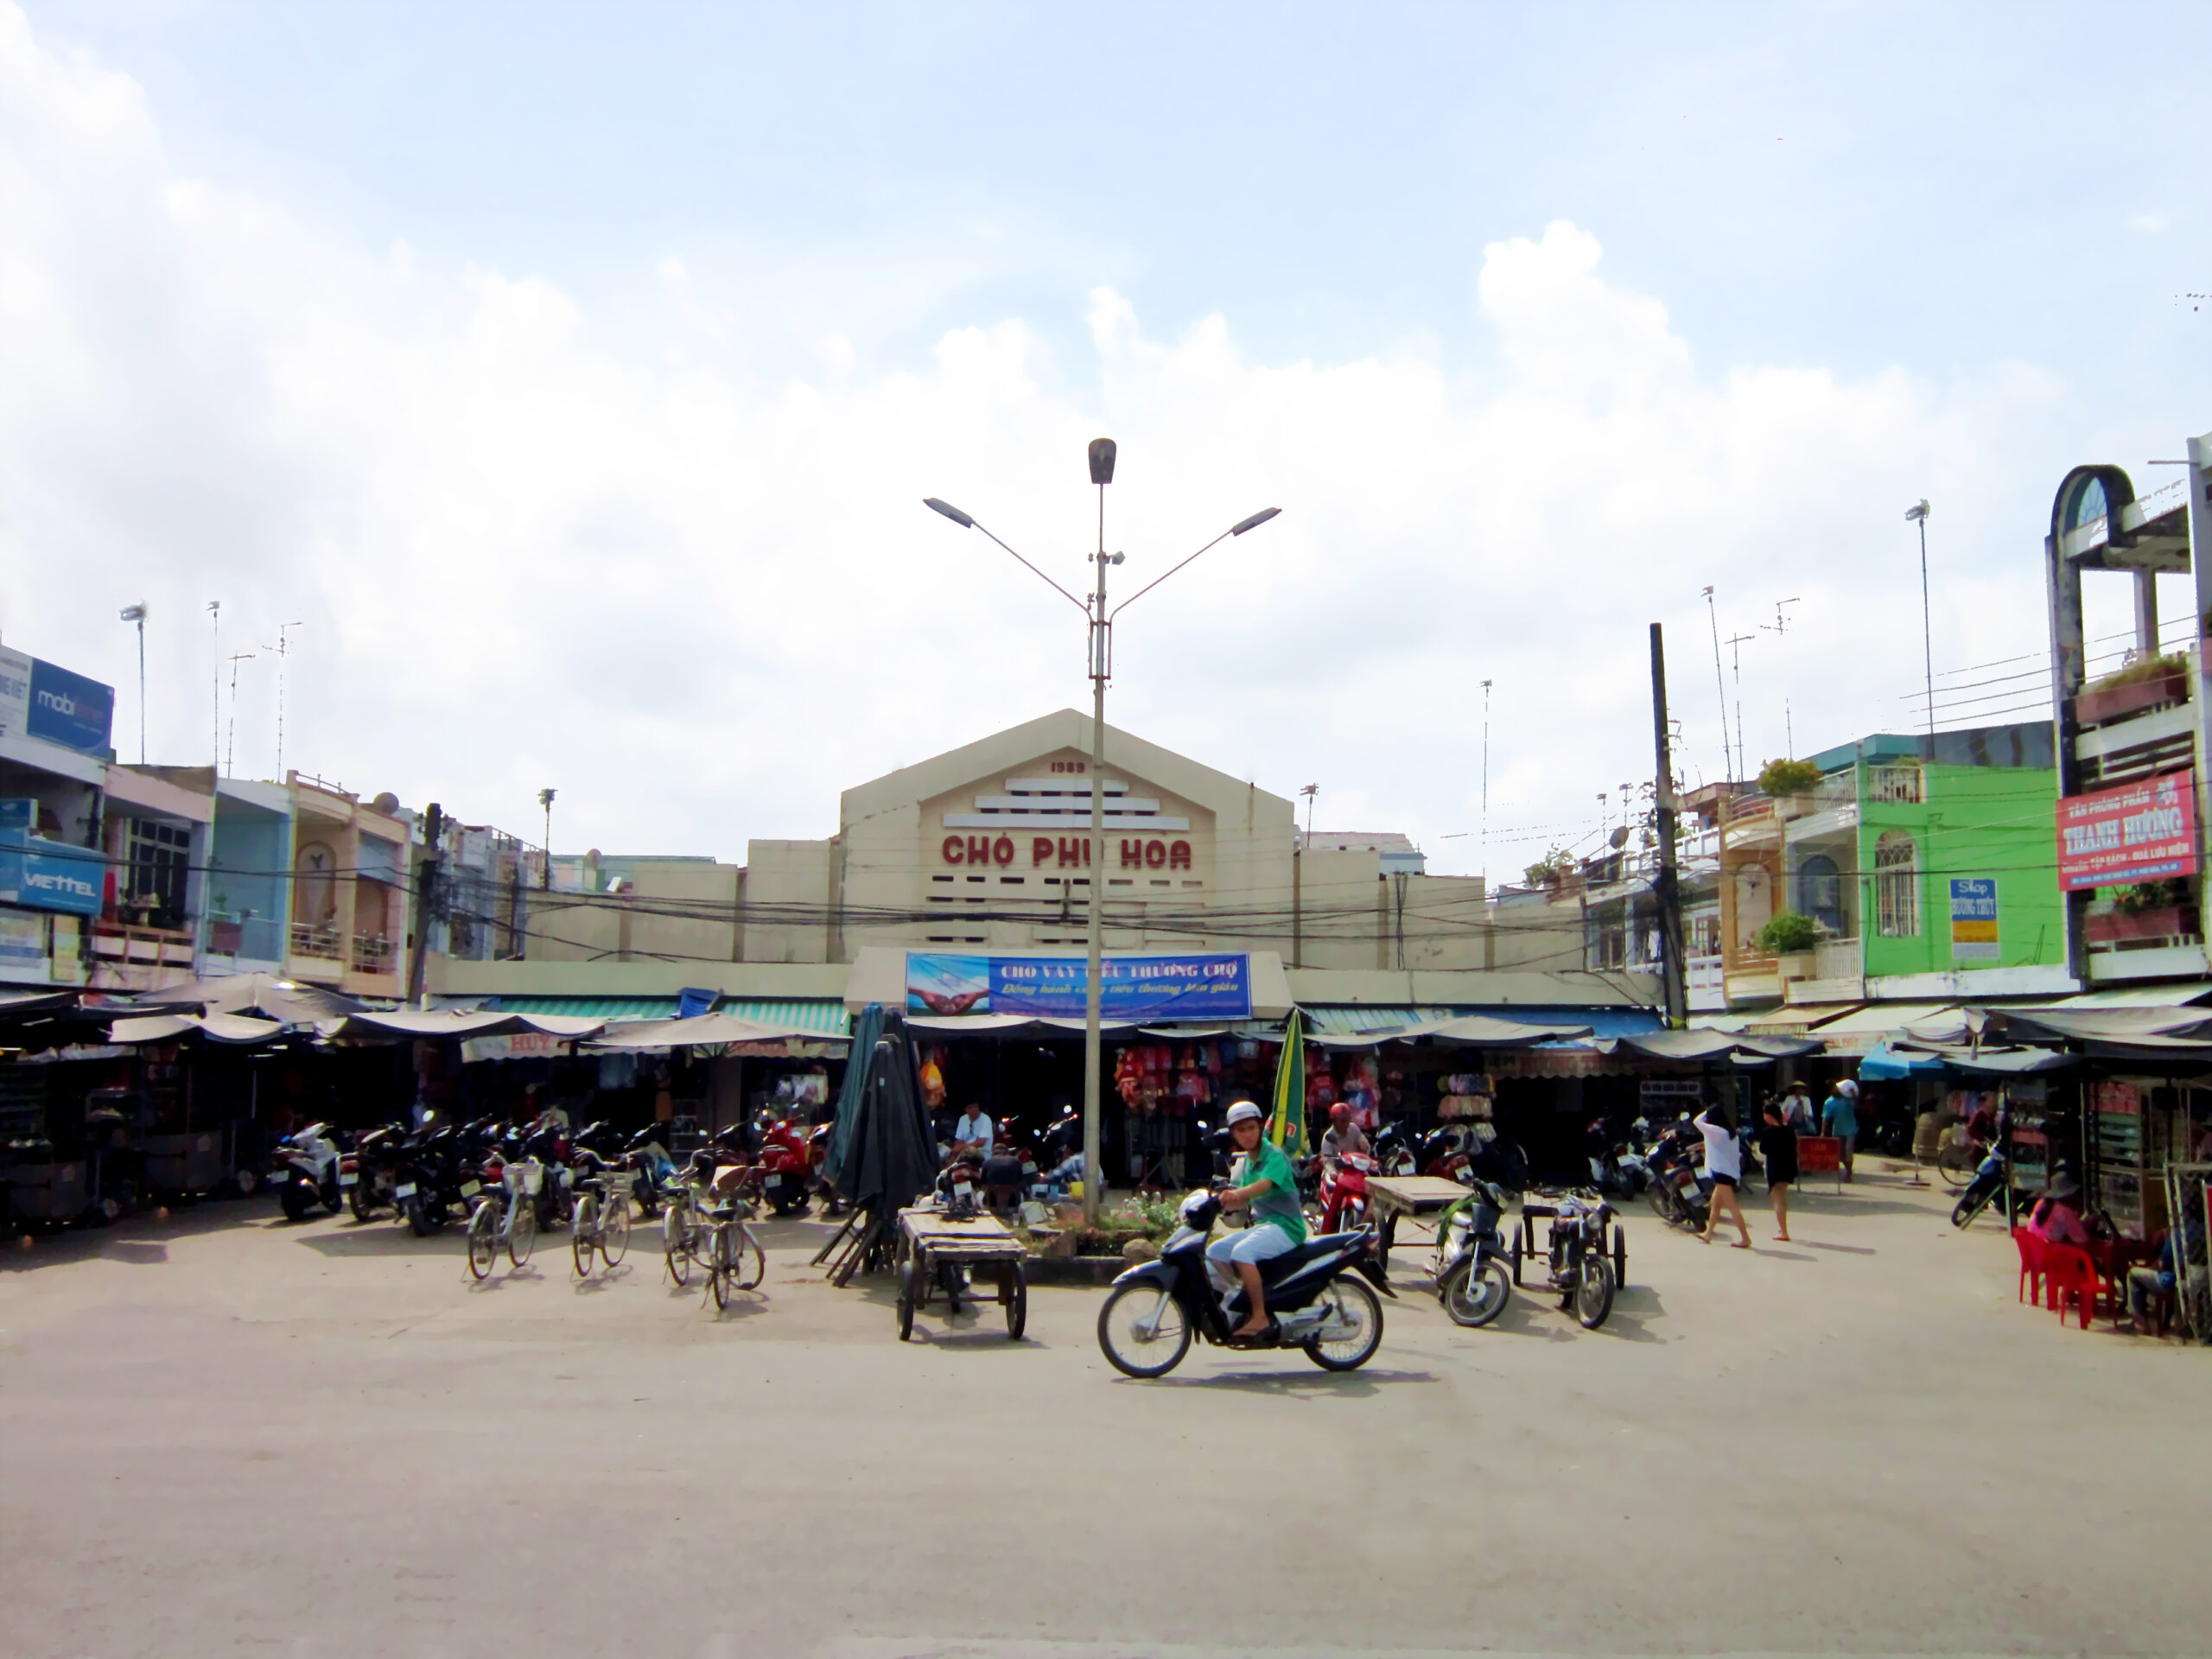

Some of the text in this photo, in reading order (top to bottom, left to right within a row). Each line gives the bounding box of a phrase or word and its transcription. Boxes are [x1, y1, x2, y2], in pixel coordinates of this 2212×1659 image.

[2063, 819, 2120, 855] THANH
[24, 873, 96, 896] VIETTEL
[1958, 879, 1988, 896] Shop
